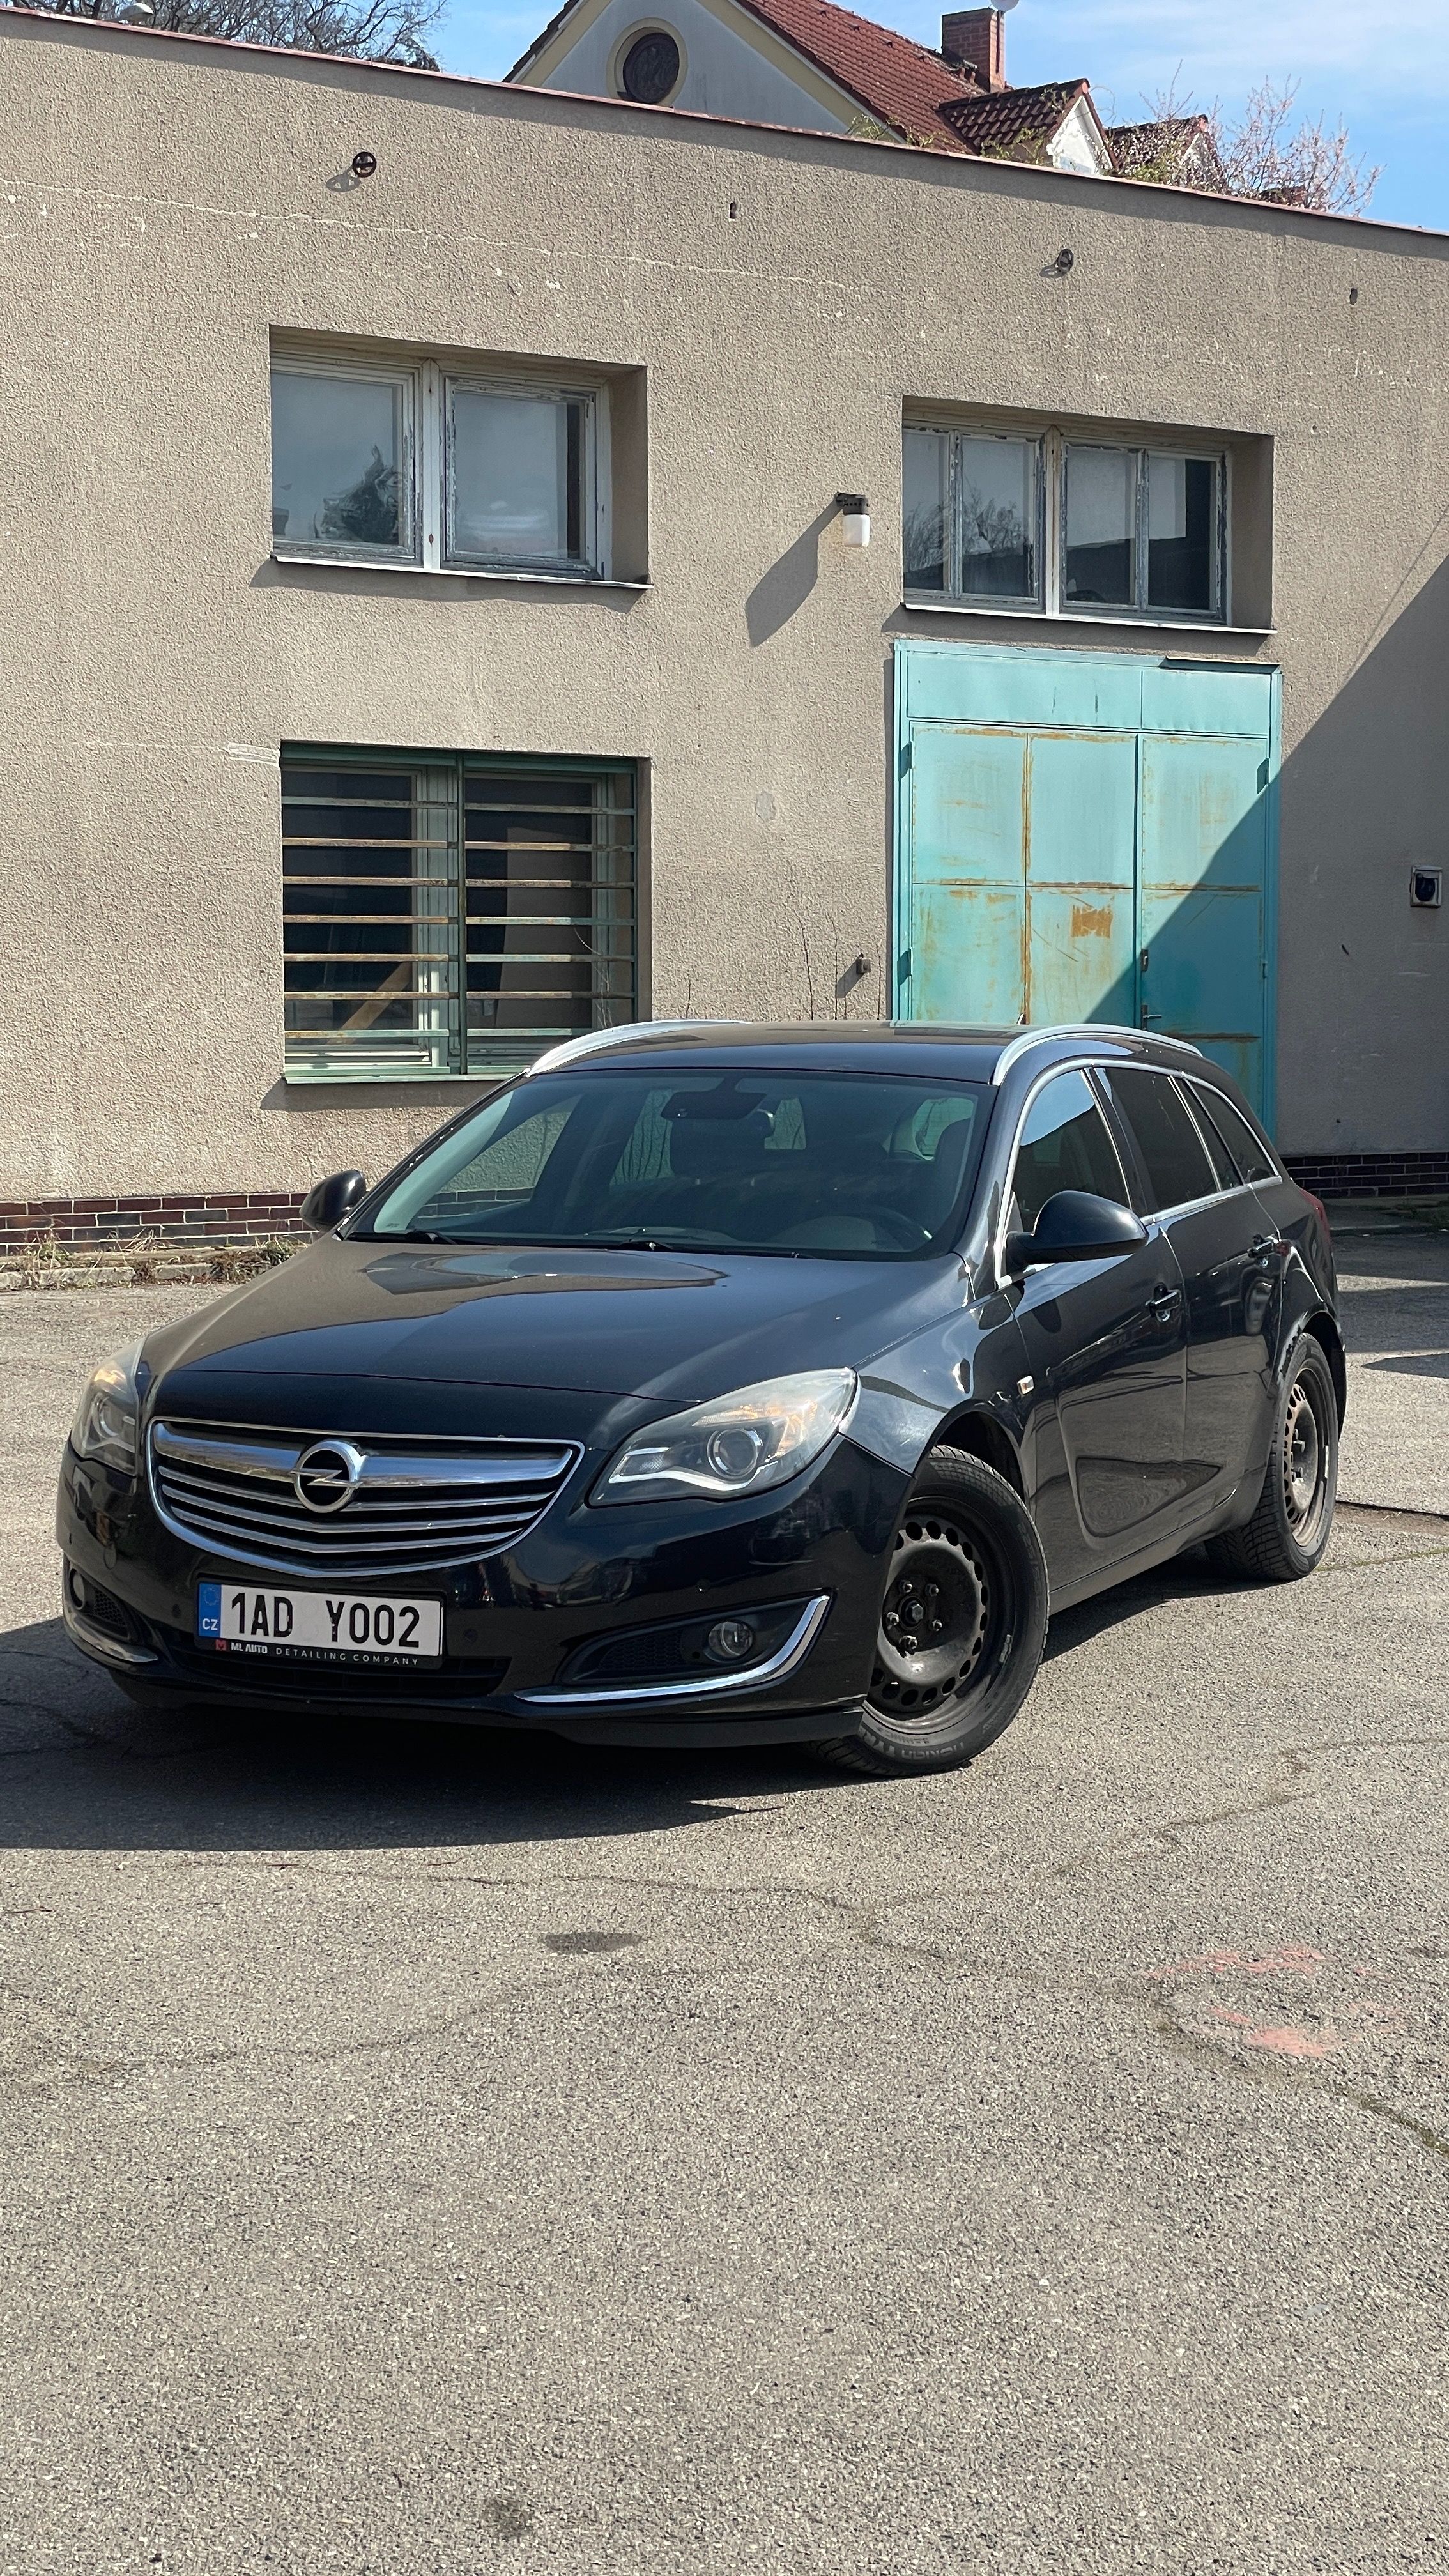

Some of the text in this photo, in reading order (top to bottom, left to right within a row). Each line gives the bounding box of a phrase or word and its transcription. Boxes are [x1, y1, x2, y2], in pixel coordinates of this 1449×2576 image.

[203, 1618, 218, 1631] CZ
[231, 1593, 420, 1648] 1AD Y002
[231, 1642, 418, 1666] ML AUTO DETAILING COMPANY
